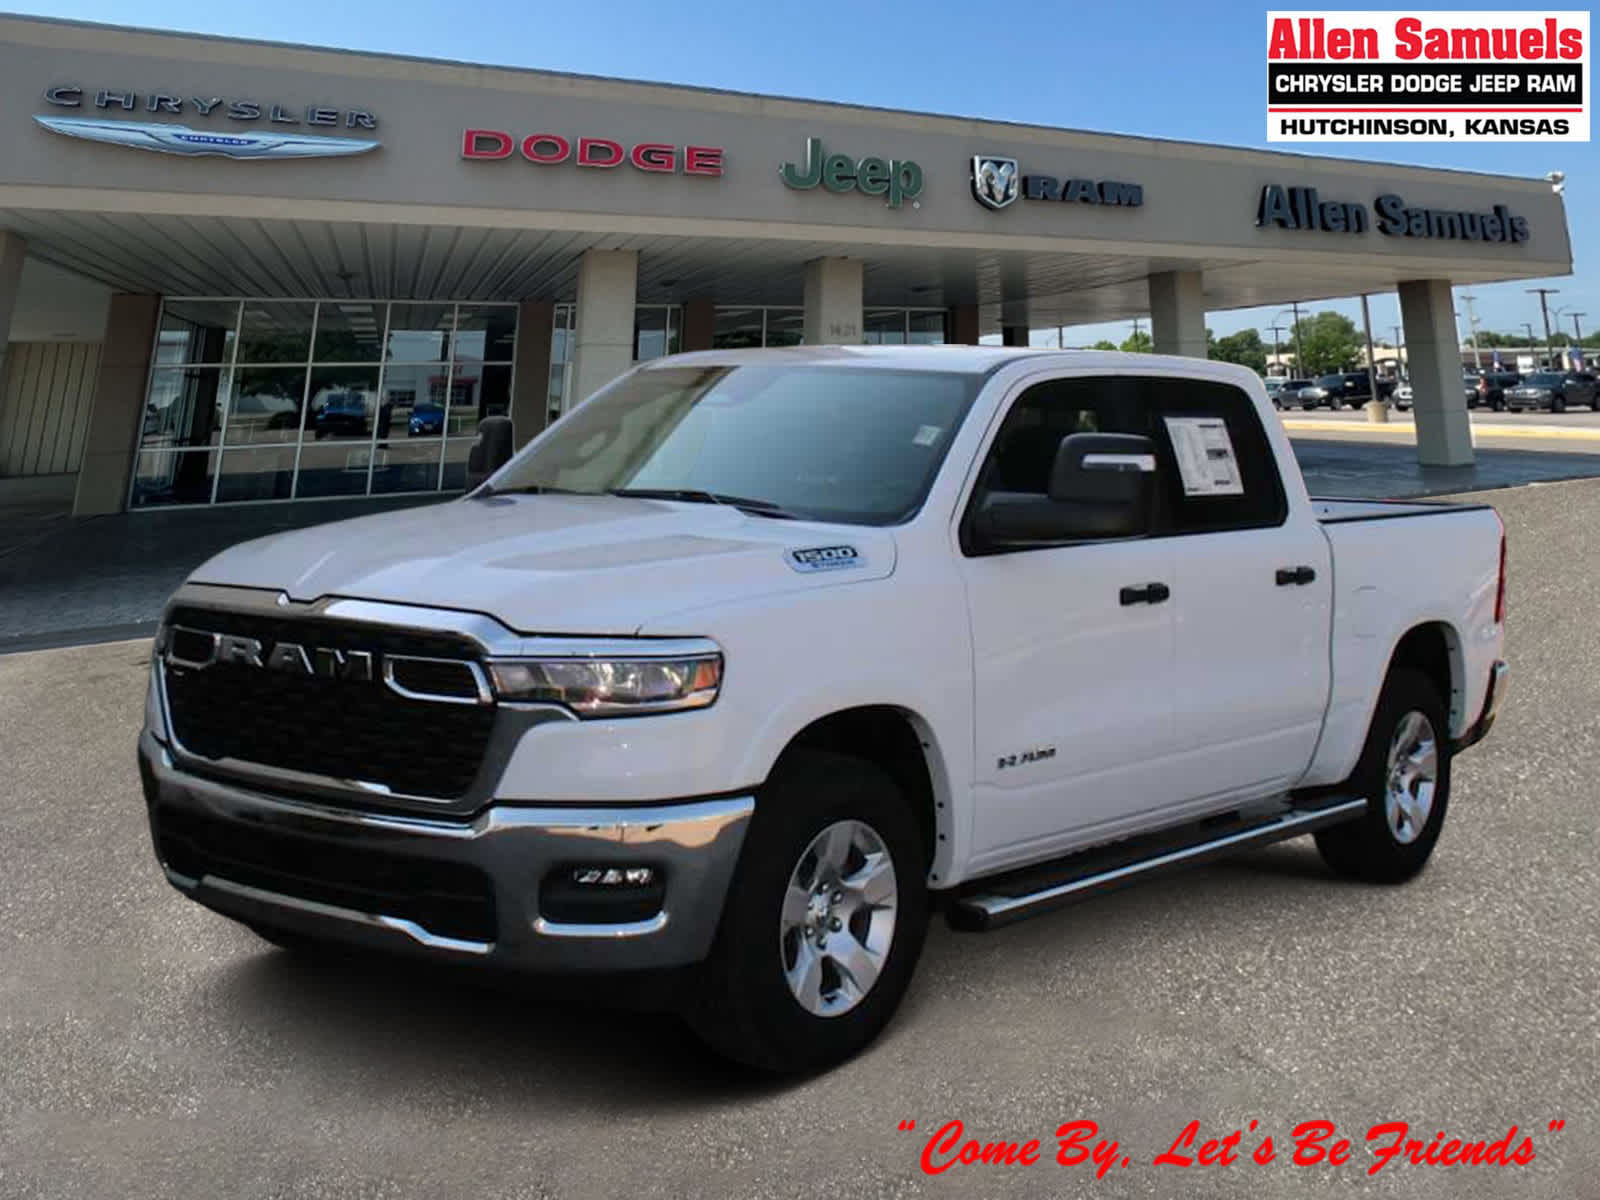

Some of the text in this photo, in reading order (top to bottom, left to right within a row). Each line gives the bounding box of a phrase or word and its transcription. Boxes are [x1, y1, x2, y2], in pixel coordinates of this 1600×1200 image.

[45, 86, 378, 129] CHRYSLER
[461, 128, 724, 177] DODGE
[779, 137, 924, 209] Jeep
[1023, 175, 1143, 207] RAM
[1256, 184, 1531, 243] Allen Samuels
[214, 633, 373, 681] RAM
